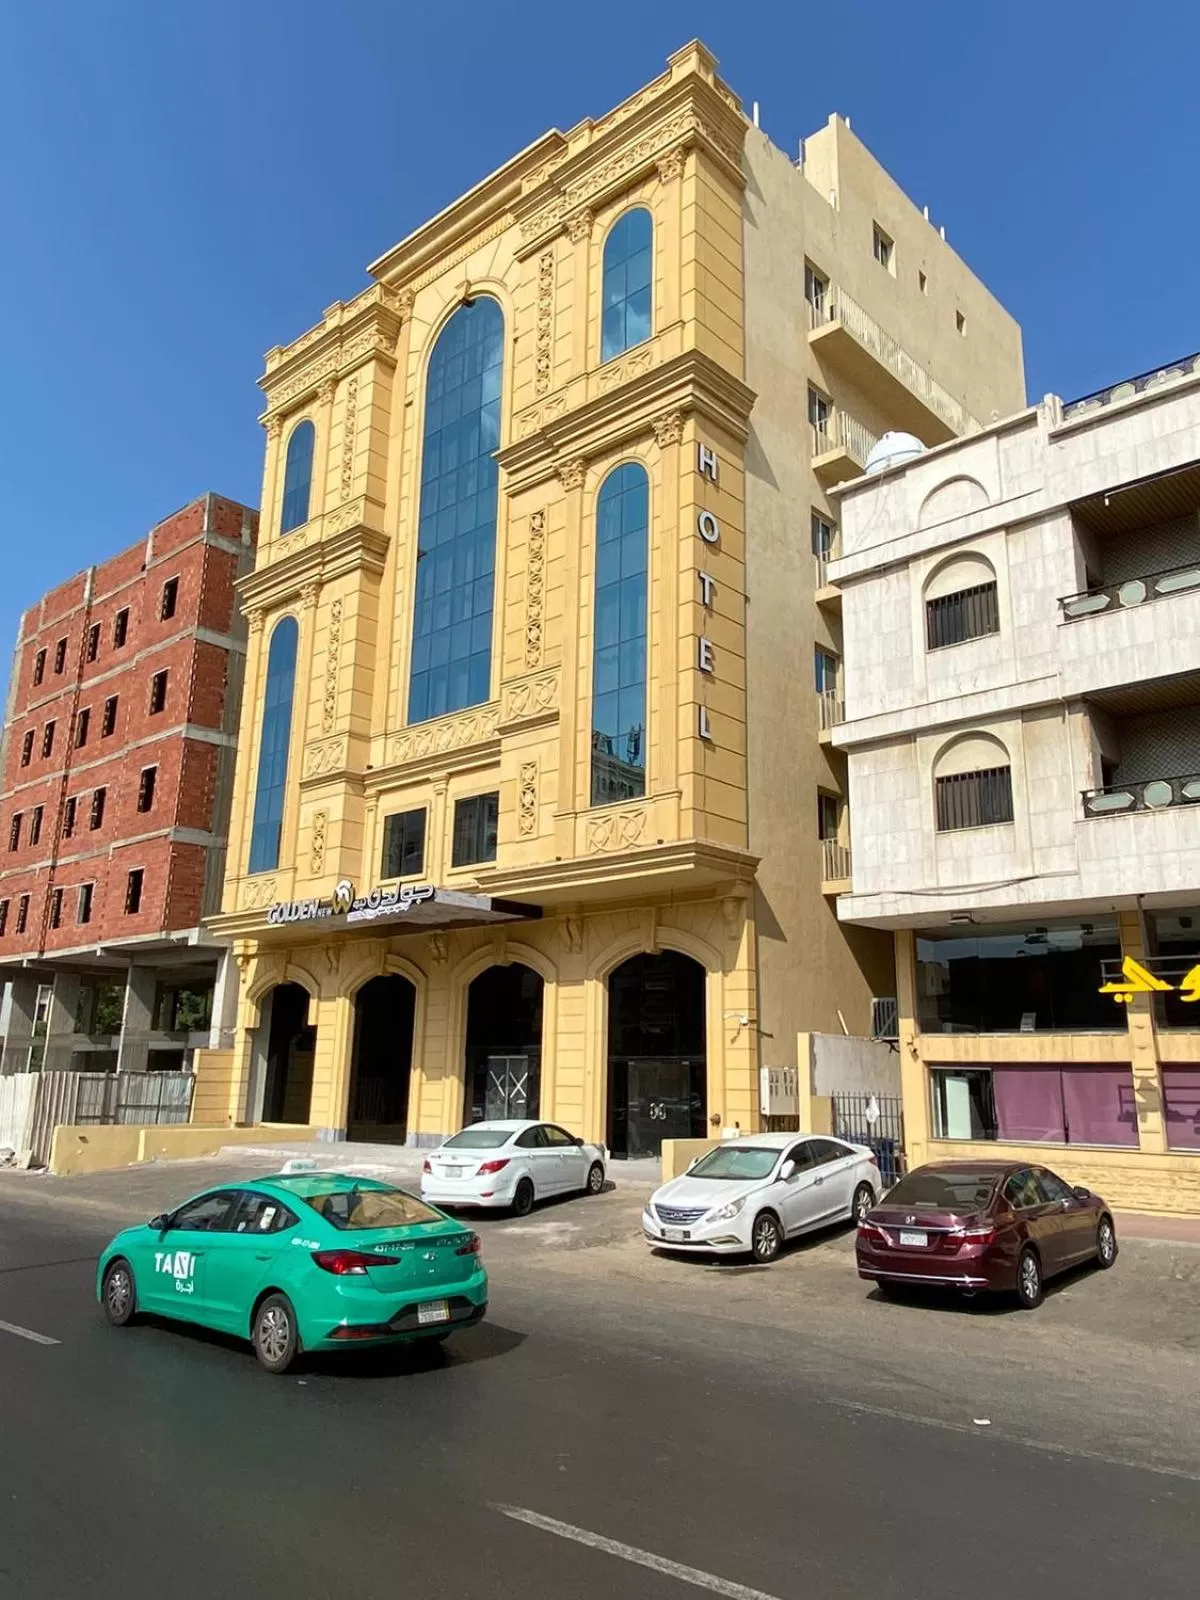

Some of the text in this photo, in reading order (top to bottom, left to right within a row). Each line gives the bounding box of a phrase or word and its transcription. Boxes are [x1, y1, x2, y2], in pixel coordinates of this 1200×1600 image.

[698, 442, 720, 739] HOTEL
[267, 899, 318, 924] GOLDEN
[154, 1250, 196, 1279] TAXI
